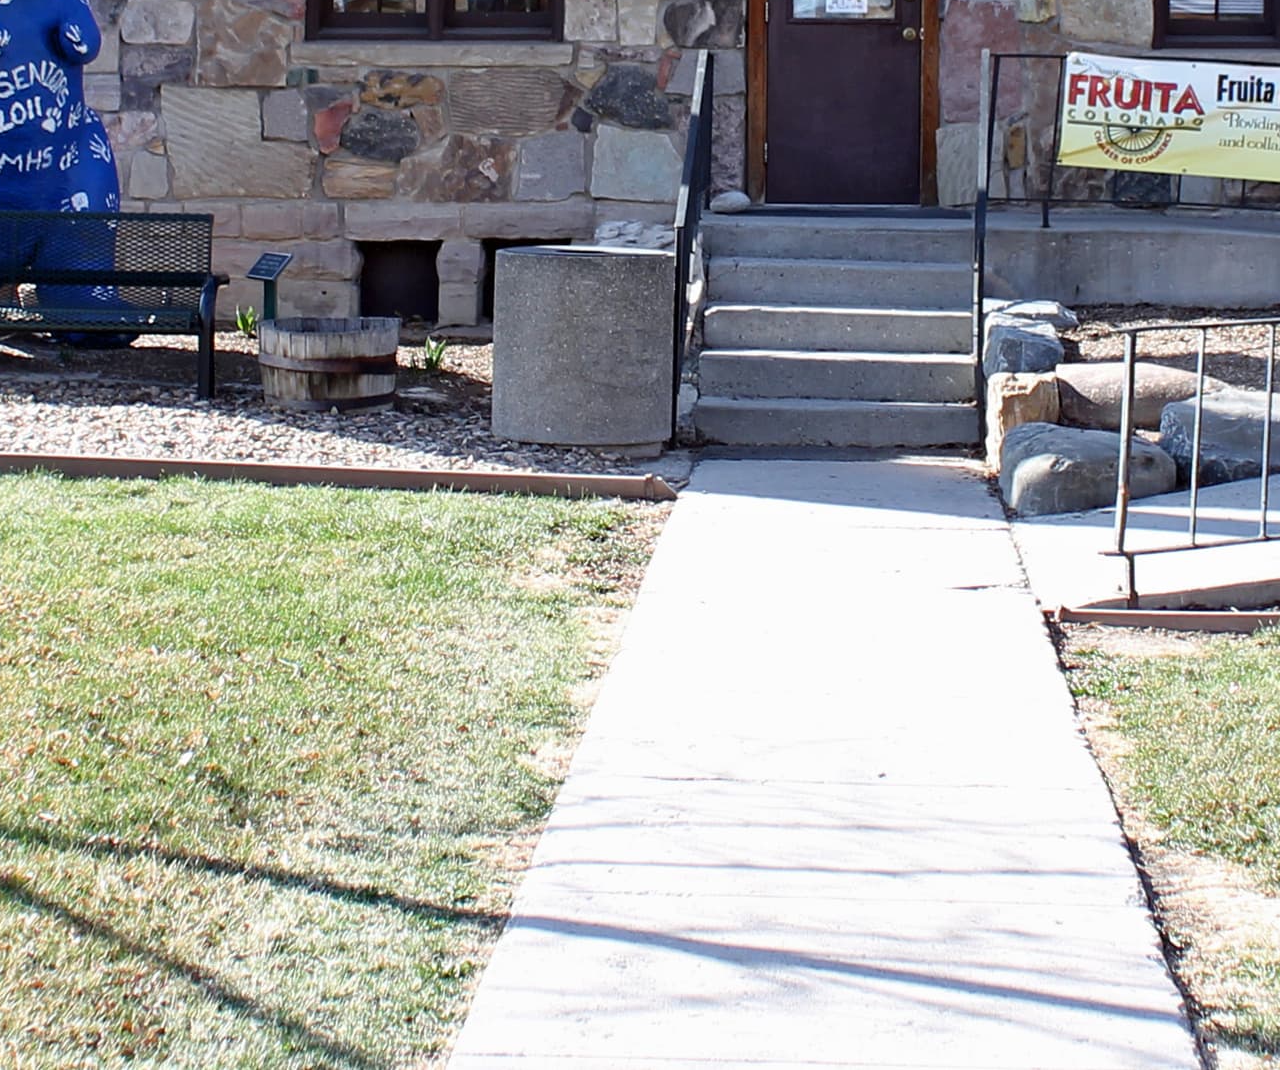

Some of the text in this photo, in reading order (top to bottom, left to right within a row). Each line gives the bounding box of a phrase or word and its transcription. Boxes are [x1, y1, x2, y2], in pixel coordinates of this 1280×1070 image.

[1067, 73, 1206, 116] FRUITA
[1216, 73, 1276, 103] Fruita
[1067, 108, 1204, 127] COLORADO
[1218, 135, 1245, 149] and
